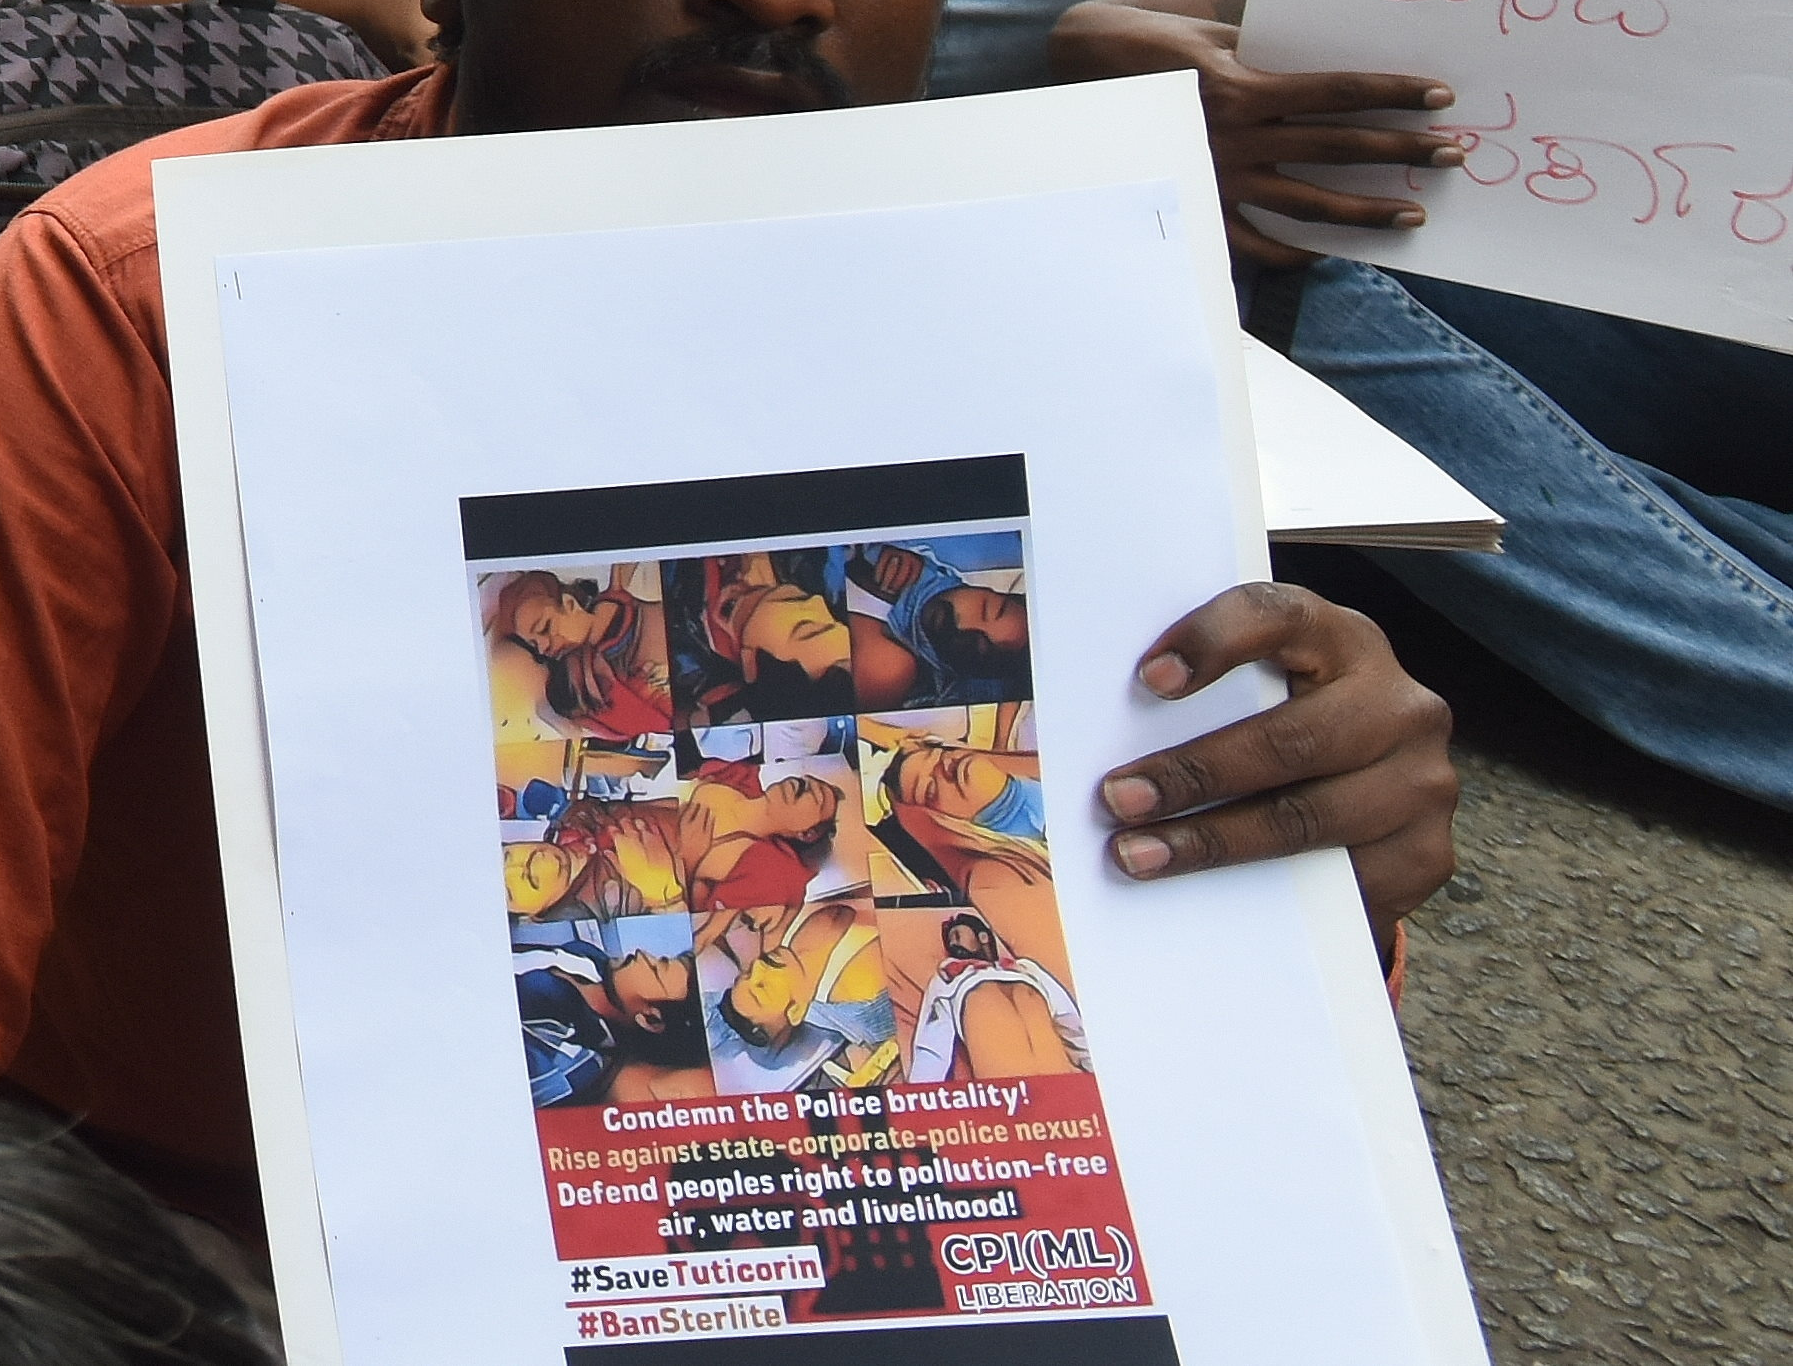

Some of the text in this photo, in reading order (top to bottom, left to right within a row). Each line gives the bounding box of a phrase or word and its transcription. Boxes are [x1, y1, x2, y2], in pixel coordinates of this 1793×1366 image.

[602, 1081, 1030, 1132] Condemn the Police brutality!
[548, 1113, 1102, 1172] Rise against state-corporate-police nexus!
[557, 1153, 1107, 1207] Defend peoples right to pollution-free
[657, 1191, 1018, 1238] air, water and livelihood!
[571, 1253, 819, 1292] #SaveTuticorin
[939, 1225, 1134, 1275] CPI(ML)
[957, 1276, 1136, 1314] LIBERATION
[577, 1304, 782, 1339] #BanSterlite
